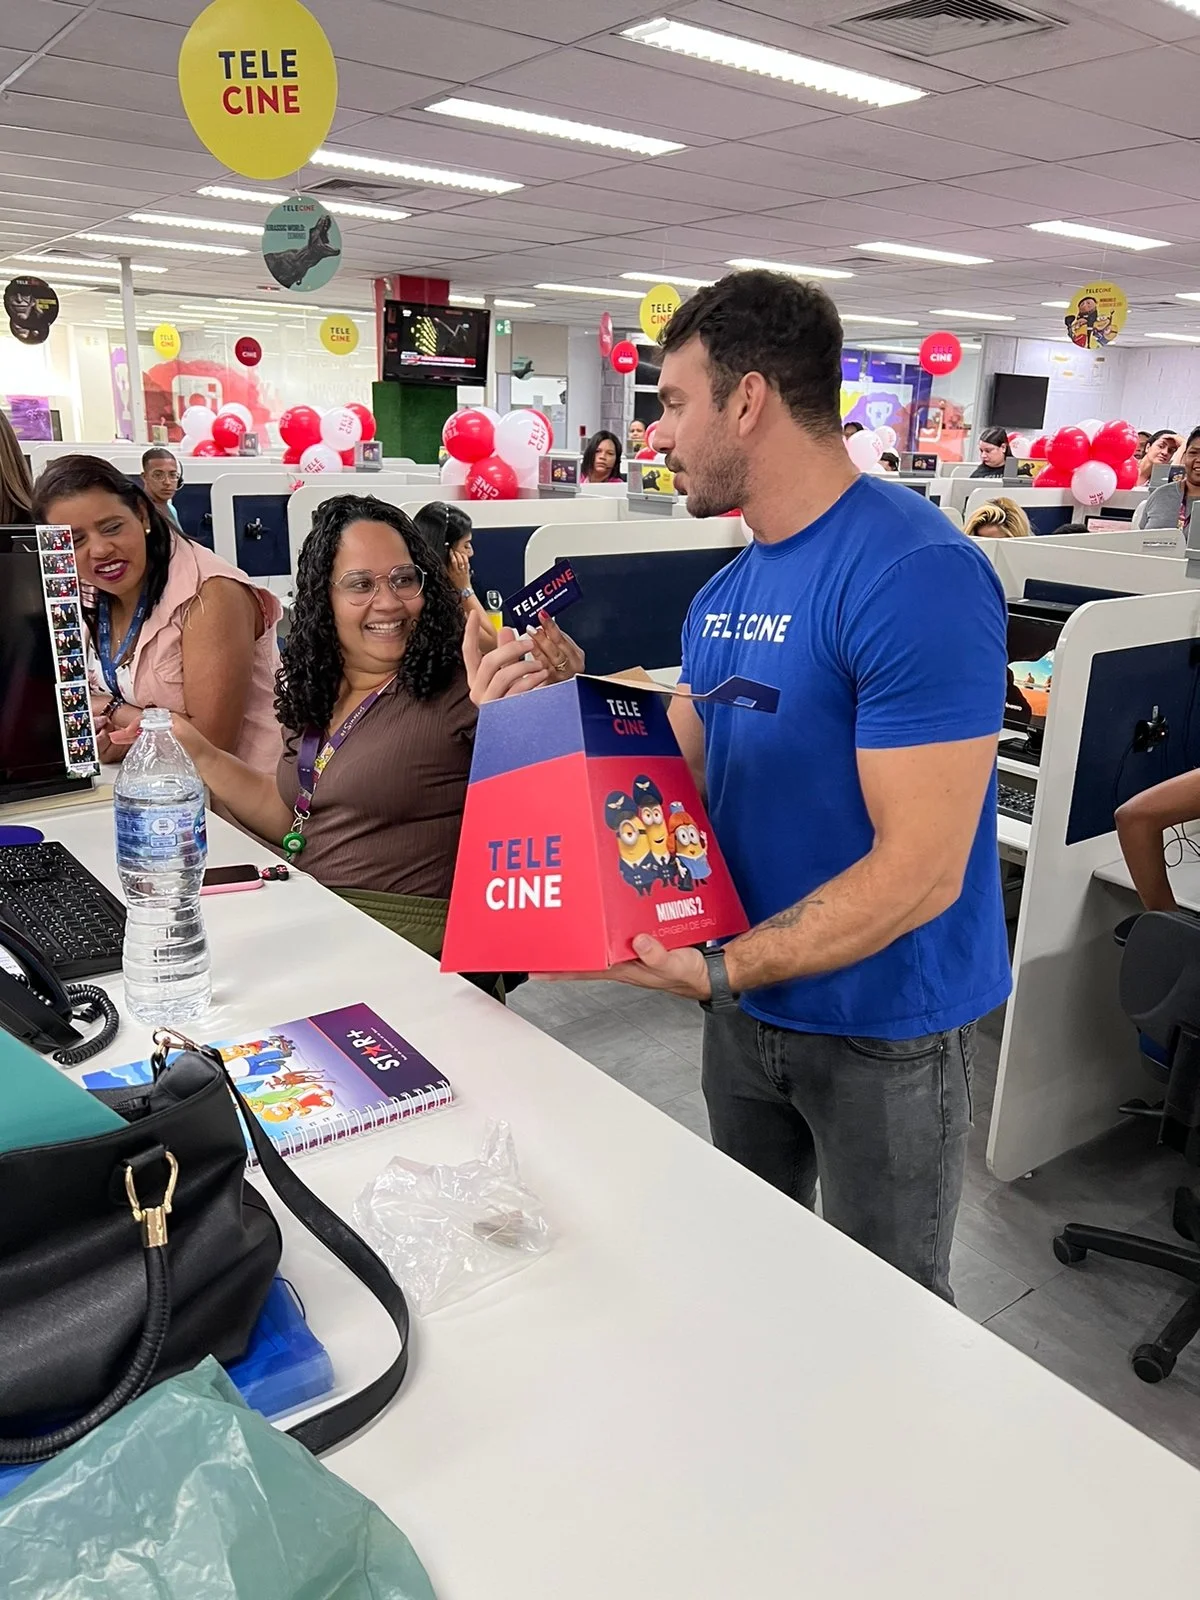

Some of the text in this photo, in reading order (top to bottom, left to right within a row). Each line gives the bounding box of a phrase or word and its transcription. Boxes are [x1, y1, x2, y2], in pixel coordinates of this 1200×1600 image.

[218, 49, 298, 79] TELE
[222, 85, 300, 115] CINE
[651, 303, 672, 313] TELE
[330, 327, 350, 335] TELE
[930, 354, 952, 362] CINE
[932, 345, 952, 353] TELE
[338, 413, 348, 431] TELE
[345, 416, 354, 434] CINE
[528, 420, 540, 446] TELE
[312, 464, 325, 473] INE
[470, 486, 491, 500] ELE
[476, 475, 499, 498] CINE
[512, 568, 574, 617] TELECINE
[702, 613, 792, 643] TELECINE
[606, 699, 641, 717] TELE
[613, 719, 648, 736] CINE
[488, 835, 562, 871] TELE
[485, 874, 562, 910] CINE
[655, 896, 704, 922] MINIONS 2
[658, 923, 688, 937] ORIGEM
[689, 920, 700, 930] DE
[700, 917, 717, 928] GRU
